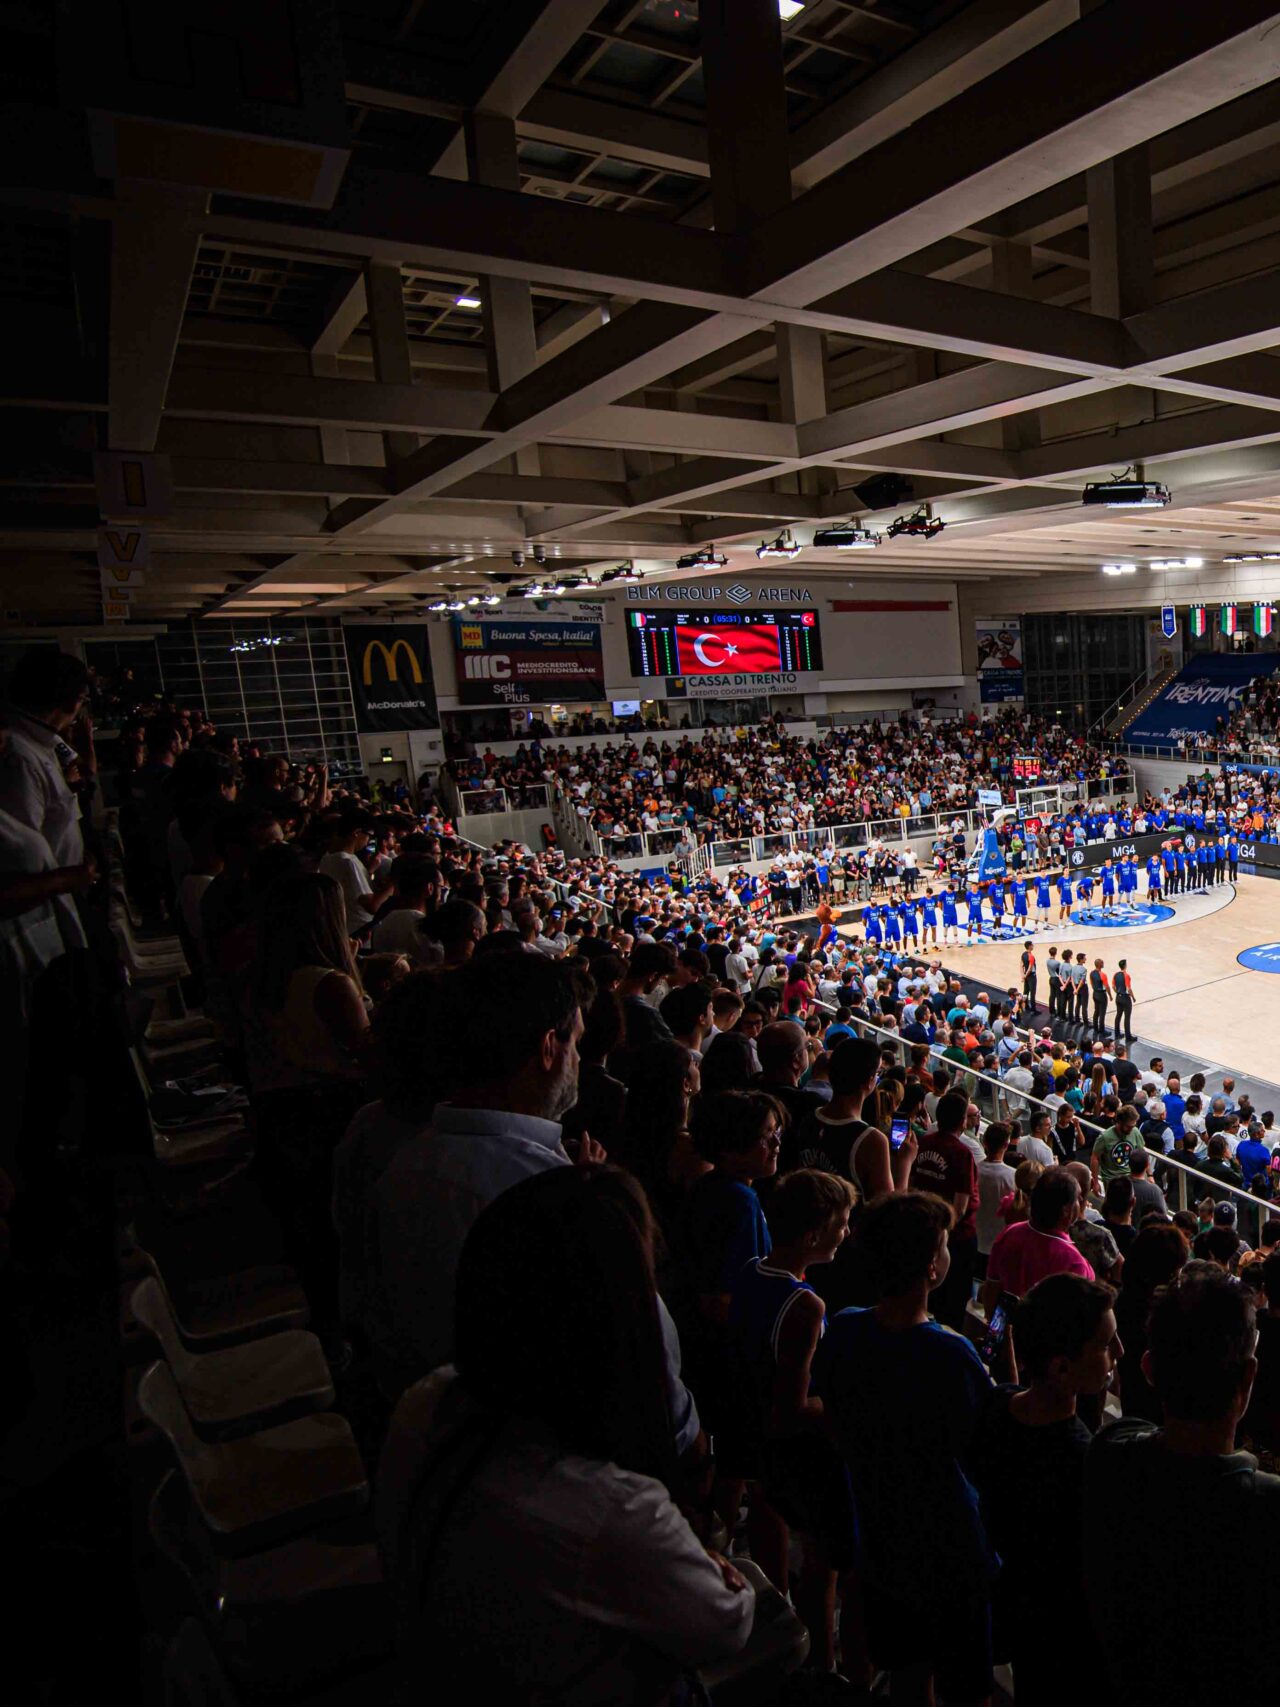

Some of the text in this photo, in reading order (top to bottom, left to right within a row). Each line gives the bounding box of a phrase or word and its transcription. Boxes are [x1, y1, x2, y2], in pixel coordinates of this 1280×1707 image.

[627, 586, 813, 601] BLM GROUP ARENA
[463, 631, 480, 641] MD
[491, 630, 594, 643] Buona Spesa, Italia!
[689, 673, 797, 688] CASSA DI TRENTO
[493, 682, 517, 695] Self
[690, 685, 798, 697] CREDITO COOPERATIVO ITALIANO
[367, 699, 426, 710] McDonald's
[504, 693, 530, 703] Plus
[1026, 765, 1041, 776] 24
[1112, 844, 1136, 858] MG4
[1237, 843, 1256, 859] G4
[917, 1150, 949, 1172] TRIUMPH
